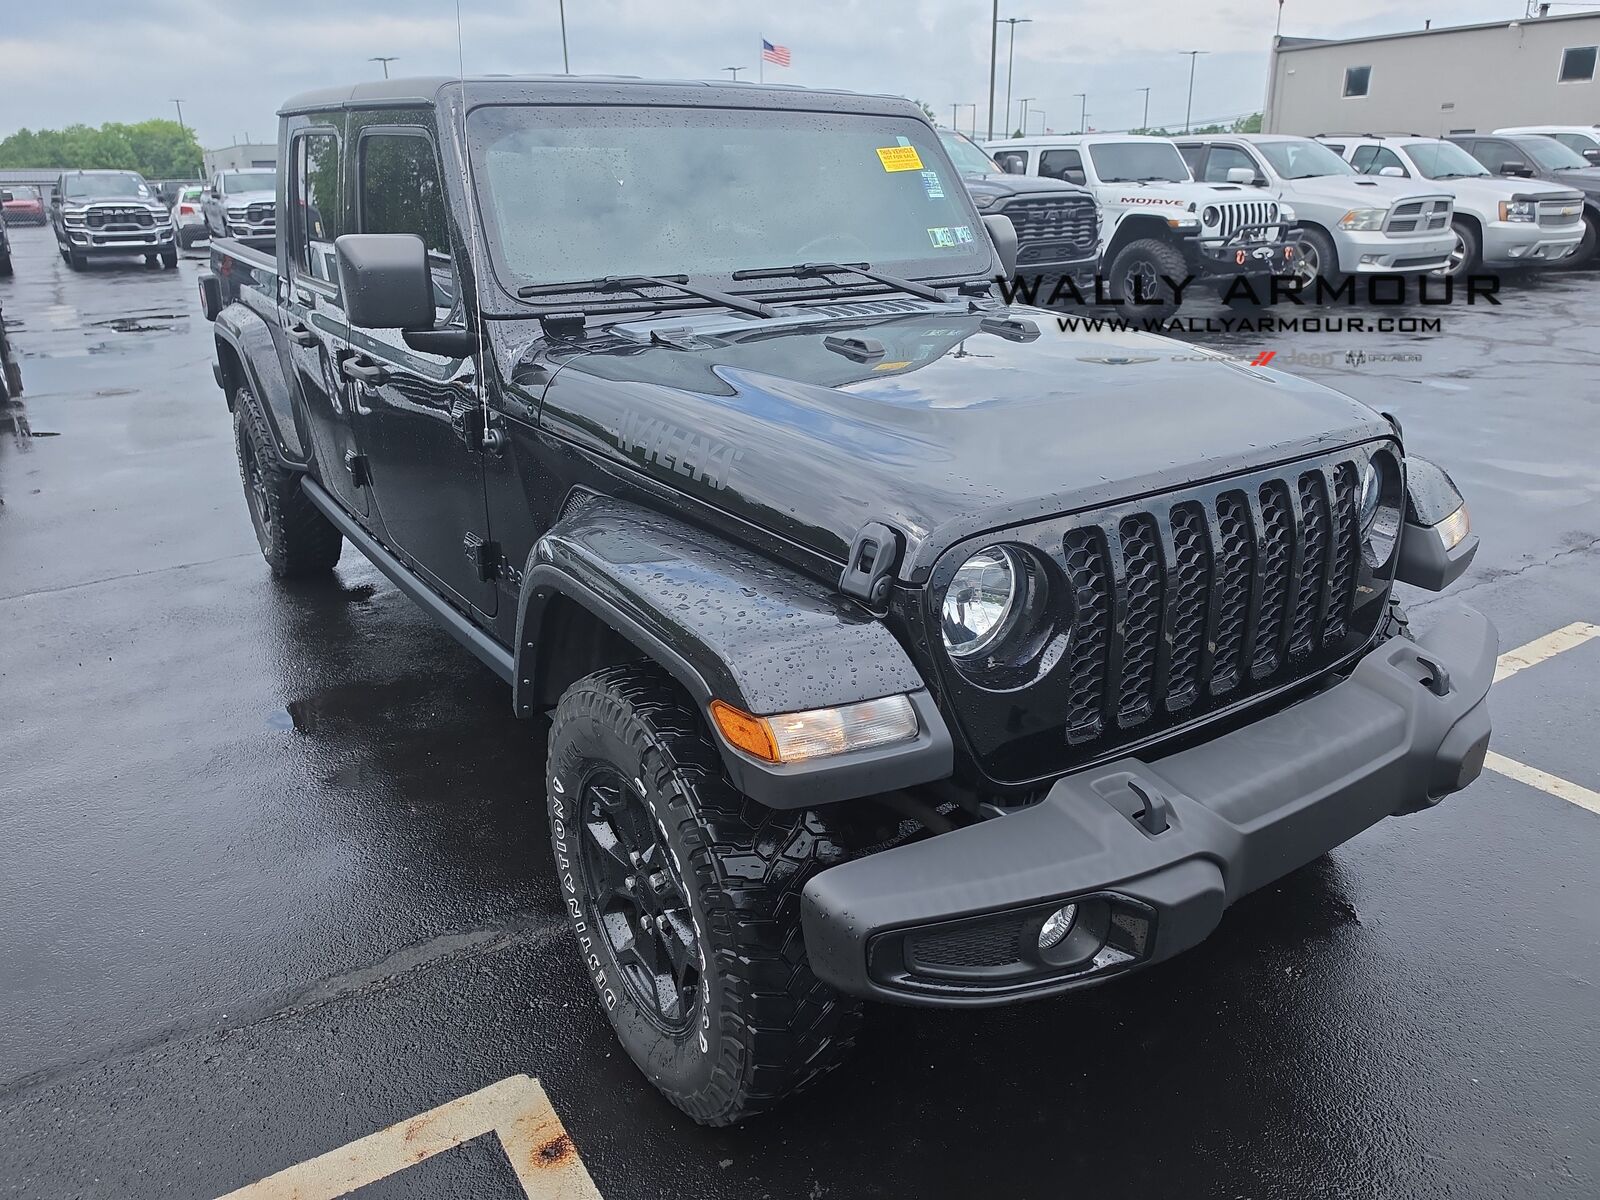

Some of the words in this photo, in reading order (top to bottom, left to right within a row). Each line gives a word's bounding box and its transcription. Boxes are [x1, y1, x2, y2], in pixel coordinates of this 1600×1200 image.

[1120, 197, 1184, 206] MOJAVE
[1028, 209, 1078, 220] RAM
[552, 795, 617, 1012] DESTINATION
